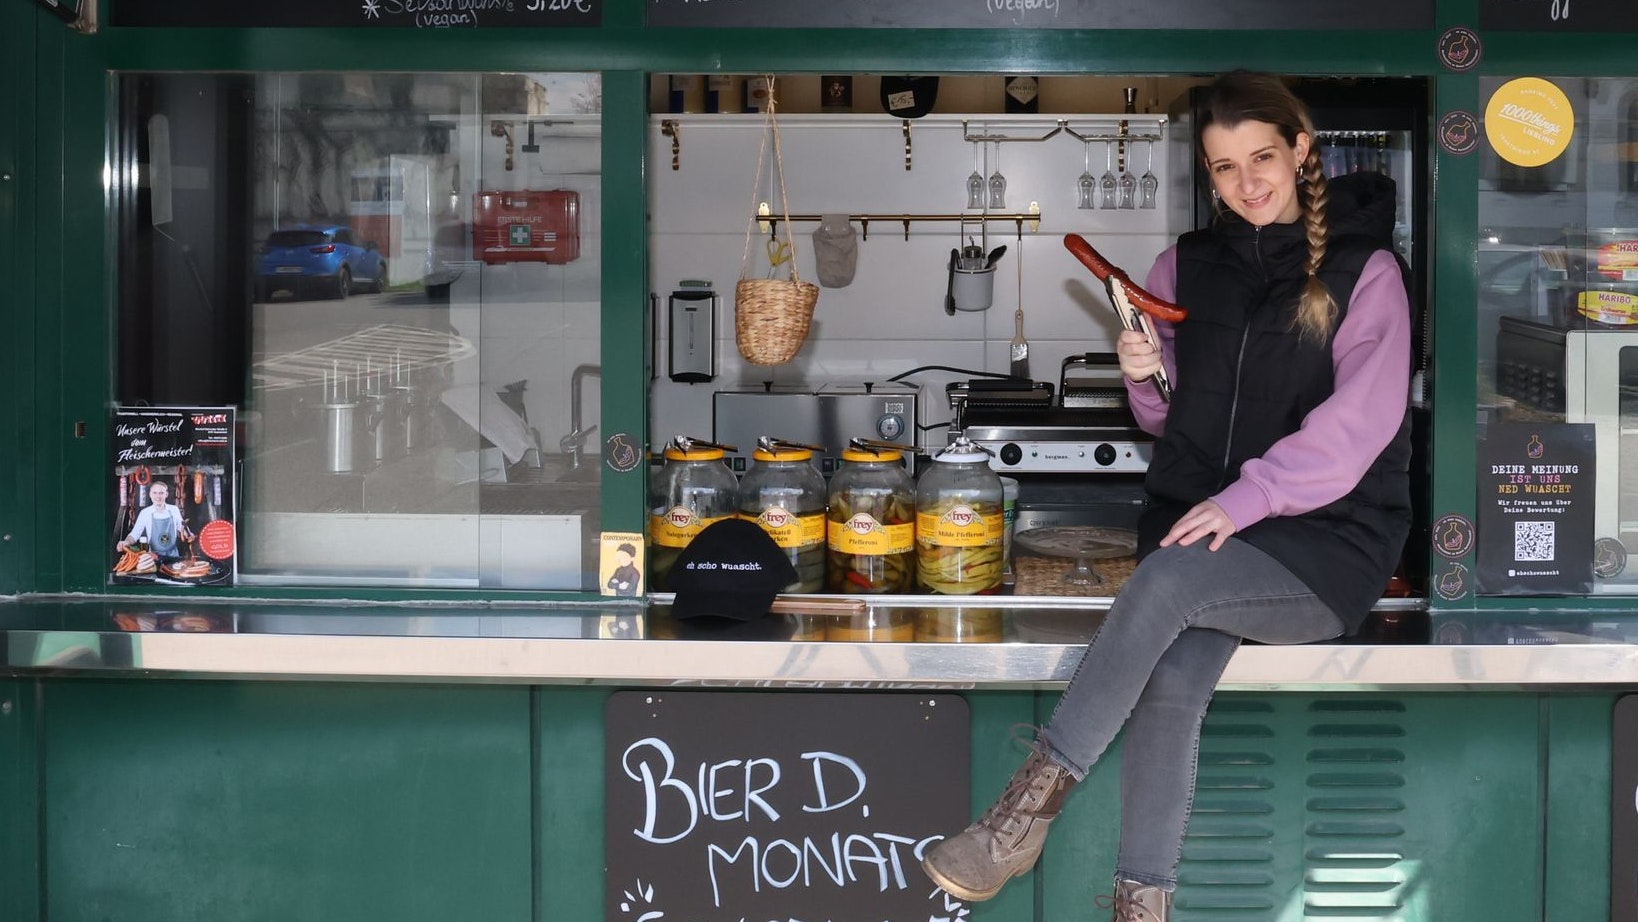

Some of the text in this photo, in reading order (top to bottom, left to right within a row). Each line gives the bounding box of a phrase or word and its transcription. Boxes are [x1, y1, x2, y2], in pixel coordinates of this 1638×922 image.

[415, 9, 478, 28] (vegan)
[1499, 103, 1562, 136] 1000things
[1598, 293, 1631, 304] HARIBO
[115, 424, 146, 437] Unsere
[117, 444, 193, 463] Fleischermeister!
[1491, 464, 1579, 475] DEINE MEINUNG
[1509, 474, 1561, 484] IST UNS
[1498, 484, 1572, 494] NED WUASCHT
[671, 512, 690, 524] frey
[766, 512, 788, 524] frey
[952, 511, 972, 523] frey
[853, 519, 873, 531] frey
[937, 530, 986, 538] Milde Pfefferoni
[848, 538, 878, 546] Pfefferoni
[686, 561, 762, 570] eh scho wuascht.
[622, 736, 870, 844] BIER D.
